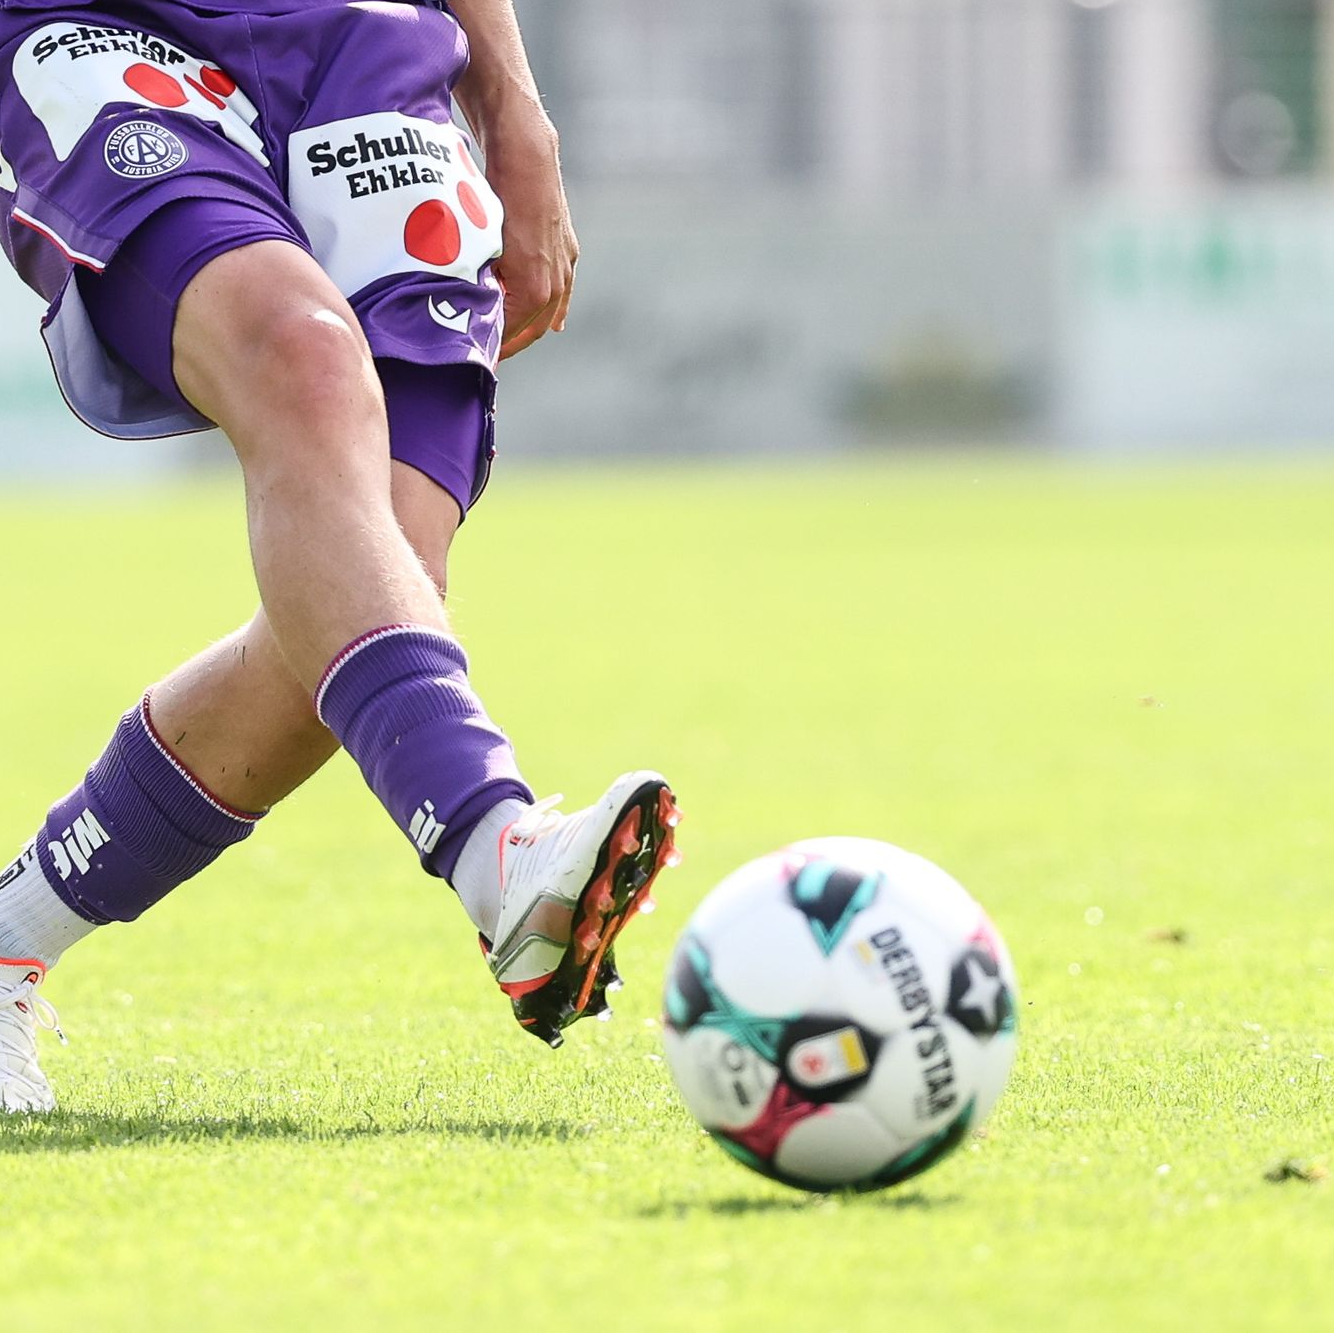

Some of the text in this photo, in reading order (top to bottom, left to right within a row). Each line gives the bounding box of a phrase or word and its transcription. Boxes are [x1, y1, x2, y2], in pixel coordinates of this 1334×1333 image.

[108, 123, 170, 150] FUSSBALLKLUB
[306, 127, 451, 178] Schuller
[122, 165, 164, 175] AUSTRIA
[346, 161, 444, 199] Eh'klar
[870, 927, 958, 1119] DERBYSTAR
